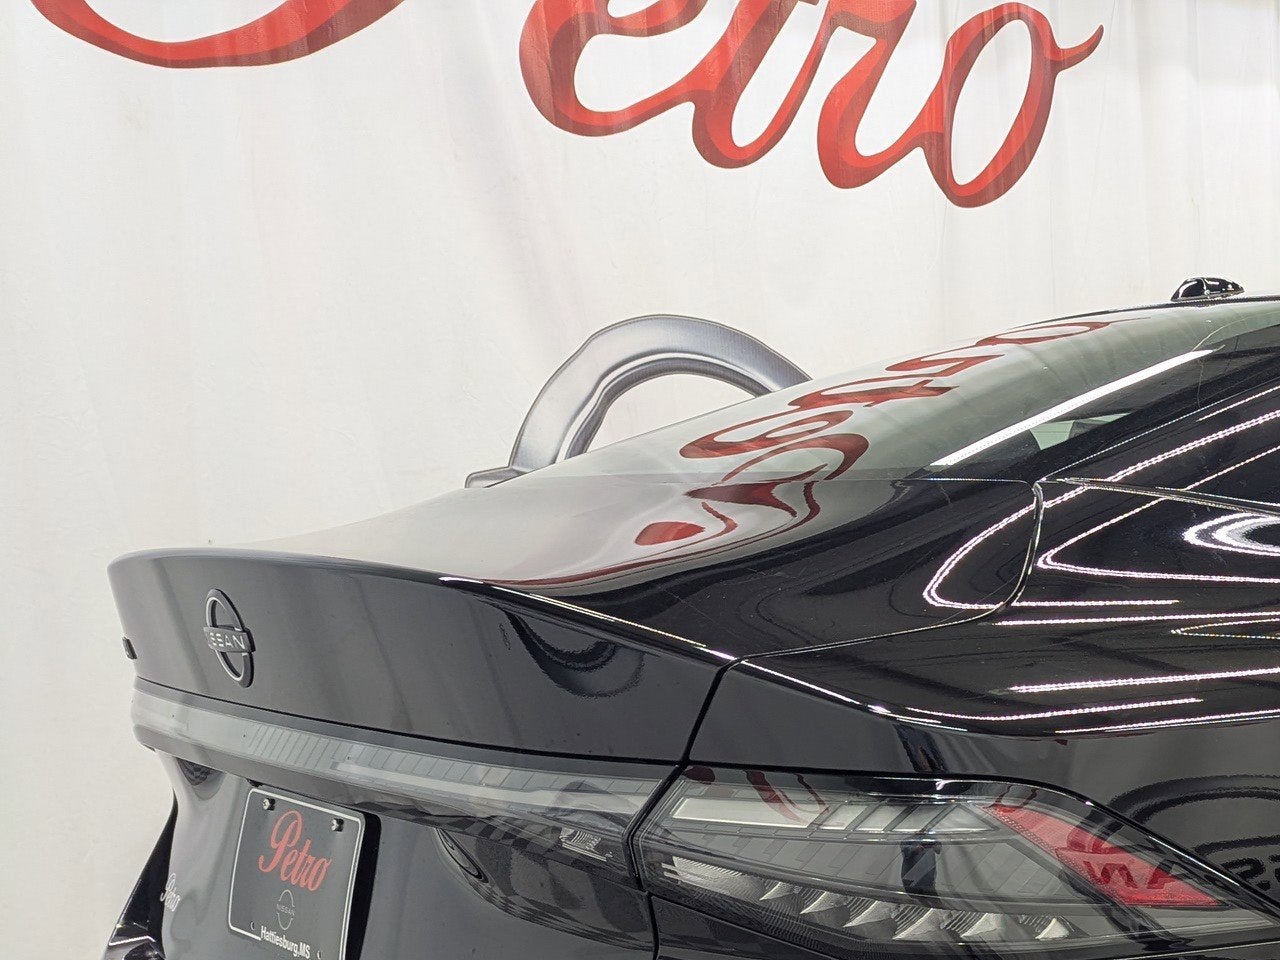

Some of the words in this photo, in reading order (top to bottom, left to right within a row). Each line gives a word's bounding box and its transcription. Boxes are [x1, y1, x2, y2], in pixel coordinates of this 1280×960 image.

[30, 0, 1104, 208] etro
[160, 872, 181, 912] Petro
[257, 810, 332, 892] Petro
